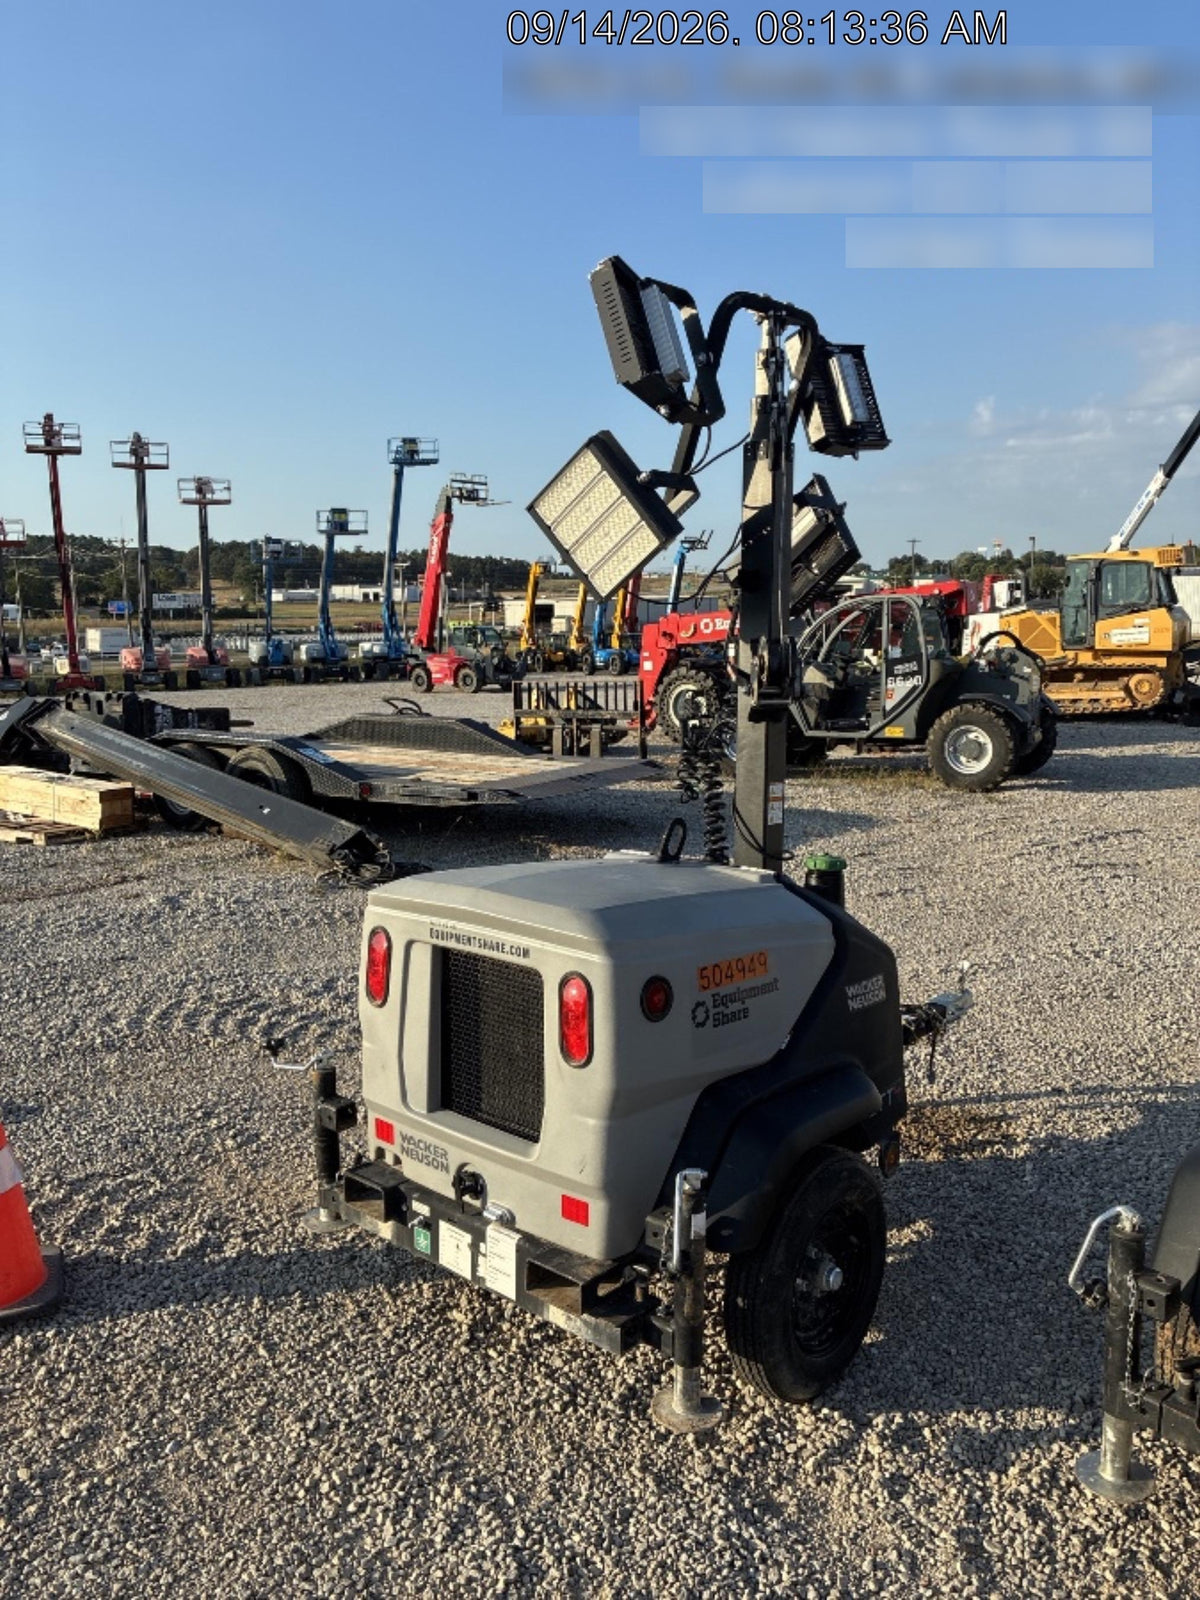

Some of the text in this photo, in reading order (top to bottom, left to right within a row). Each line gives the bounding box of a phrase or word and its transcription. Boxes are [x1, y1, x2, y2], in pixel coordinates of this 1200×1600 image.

[429, 927, 531, 959] EQUIPMENTSHARE.COM
[699, 951, 768, 991] 504949
[711, 977, 780, 1009] Equipment
[712, 1006, 750, 1028] Share
[399, 1130, 449, 1161] WACKER
[400, 1144, 451, 1174] NEUSON
